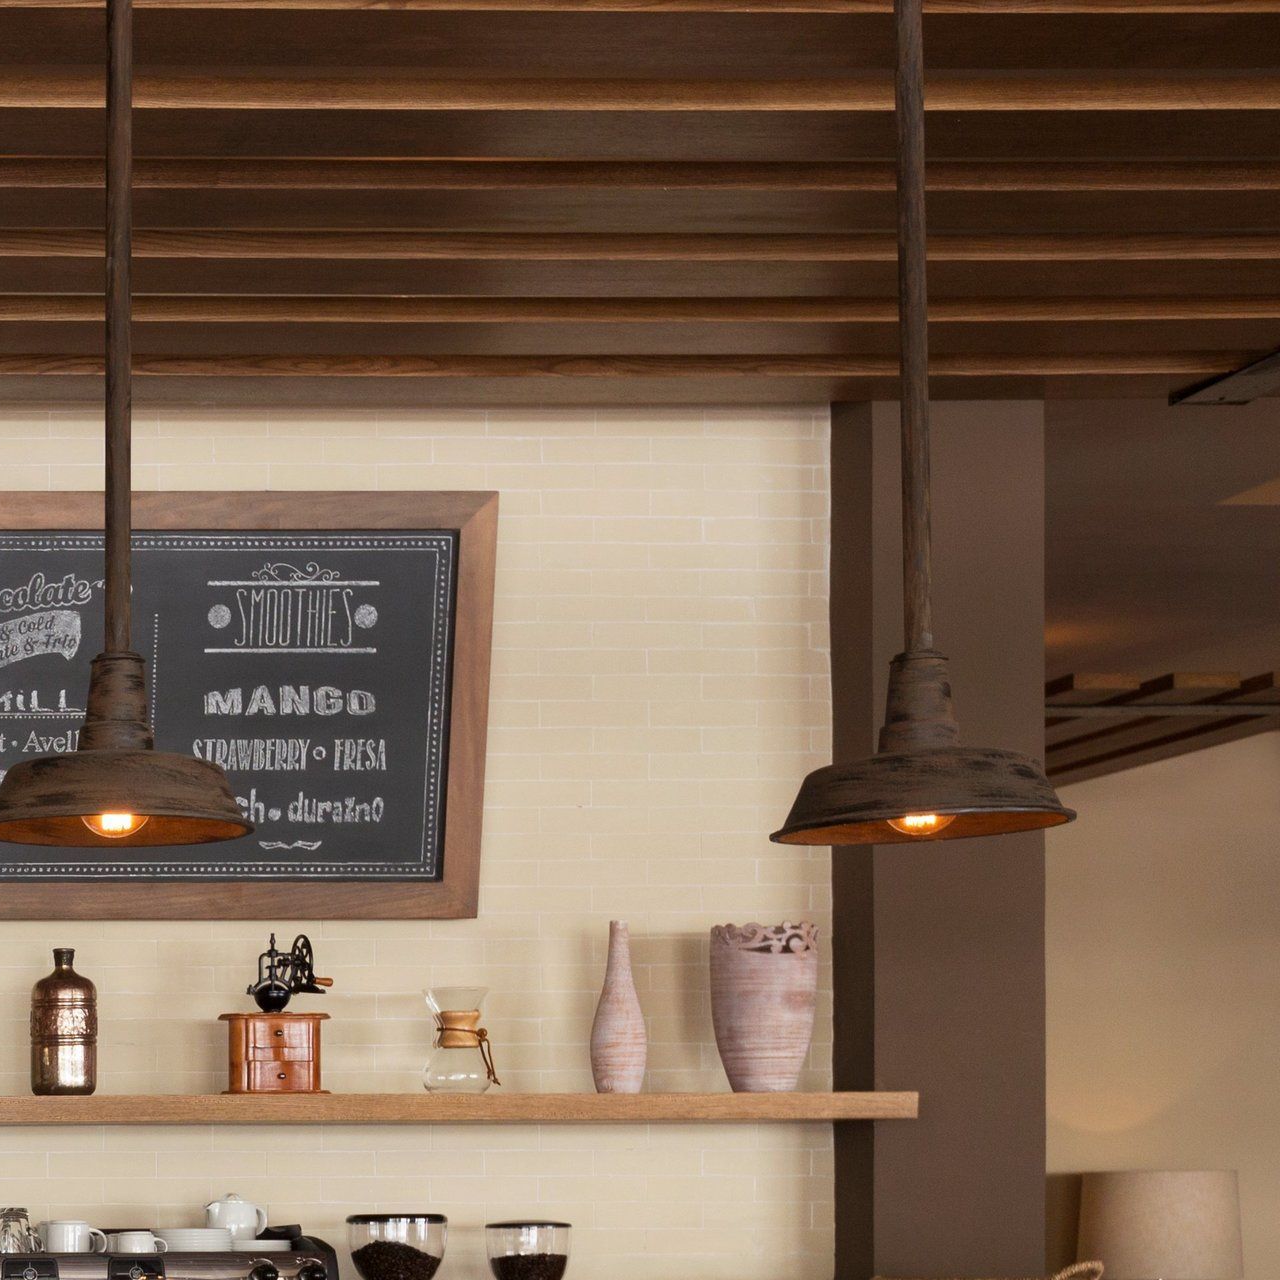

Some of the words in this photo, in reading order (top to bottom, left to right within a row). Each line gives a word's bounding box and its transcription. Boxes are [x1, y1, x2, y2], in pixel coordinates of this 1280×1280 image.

[0, 626, 14, 643] &
[17, 615, 56, 636] Cold
[234, 588, 353, 647] SMOOTHIES
[23, 637, 39, 653] &
[204, 685, 376, 716] MANGO
[22, 730, 80, 753] Avell
[192, 738, 310, 771] STRAWBERRY
[334, 738, 387, 771] FRESA
[288, 791, 385, 823] durazno
